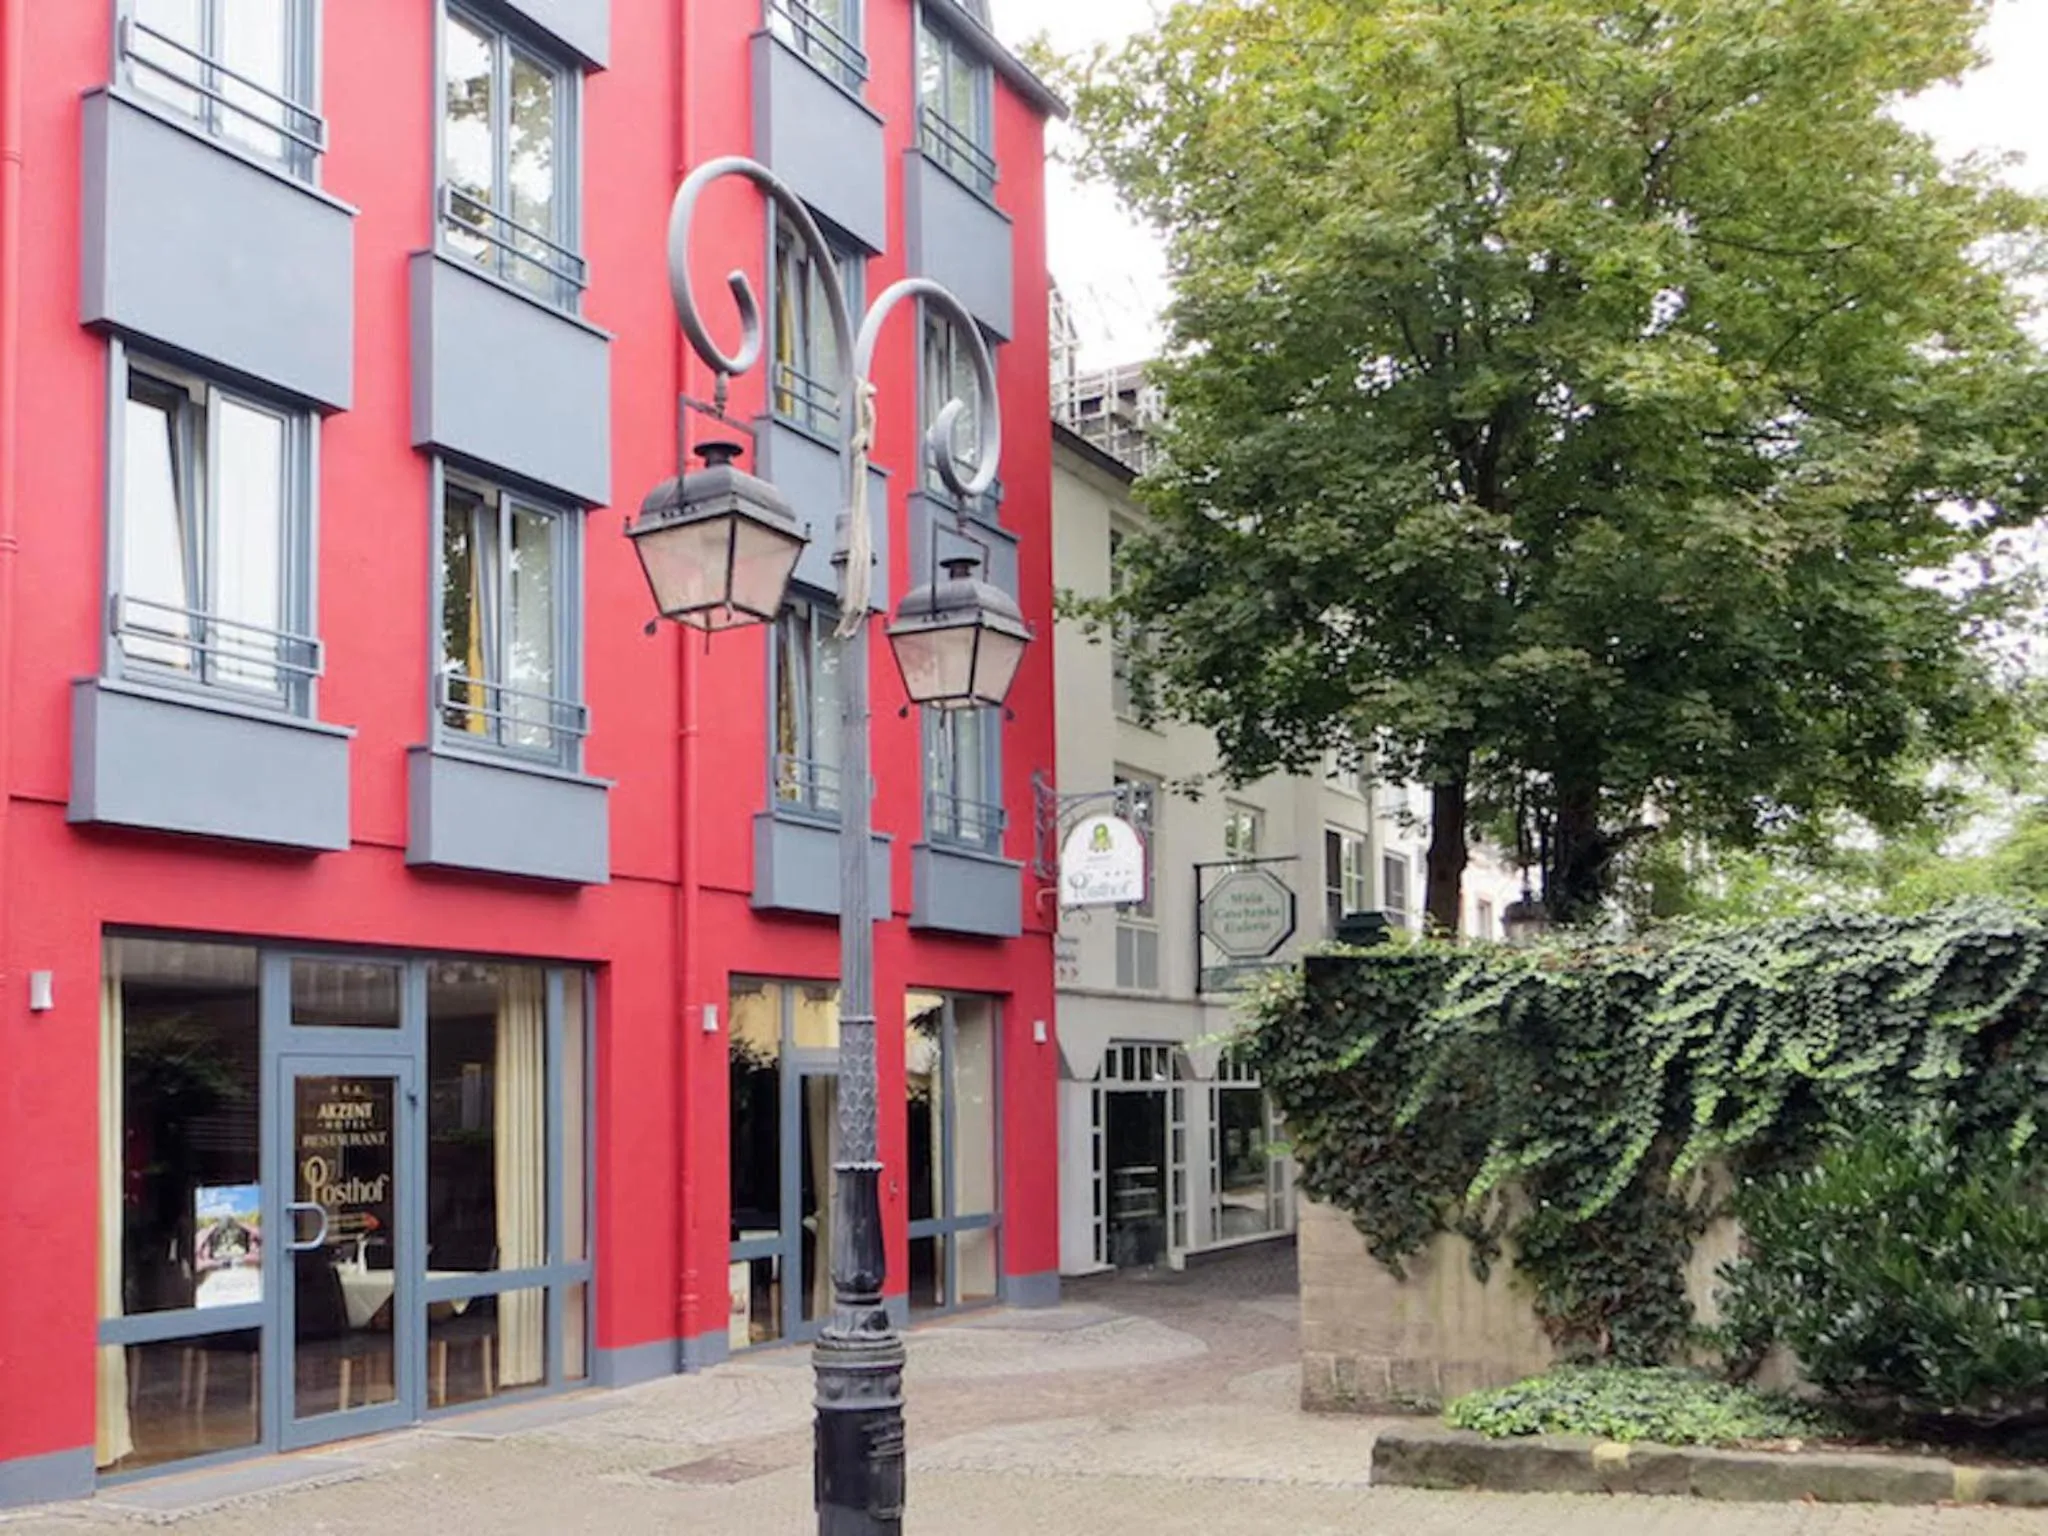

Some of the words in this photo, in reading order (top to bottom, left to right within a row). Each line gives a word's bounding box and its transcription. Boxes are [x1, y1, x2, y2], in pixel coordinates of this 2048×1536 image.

[316, 1101, 373, 1119] AKZENT
[302, 1130, 388, 1147] RESTAURANT
[304, 1155, 391, 1206] Posthof
